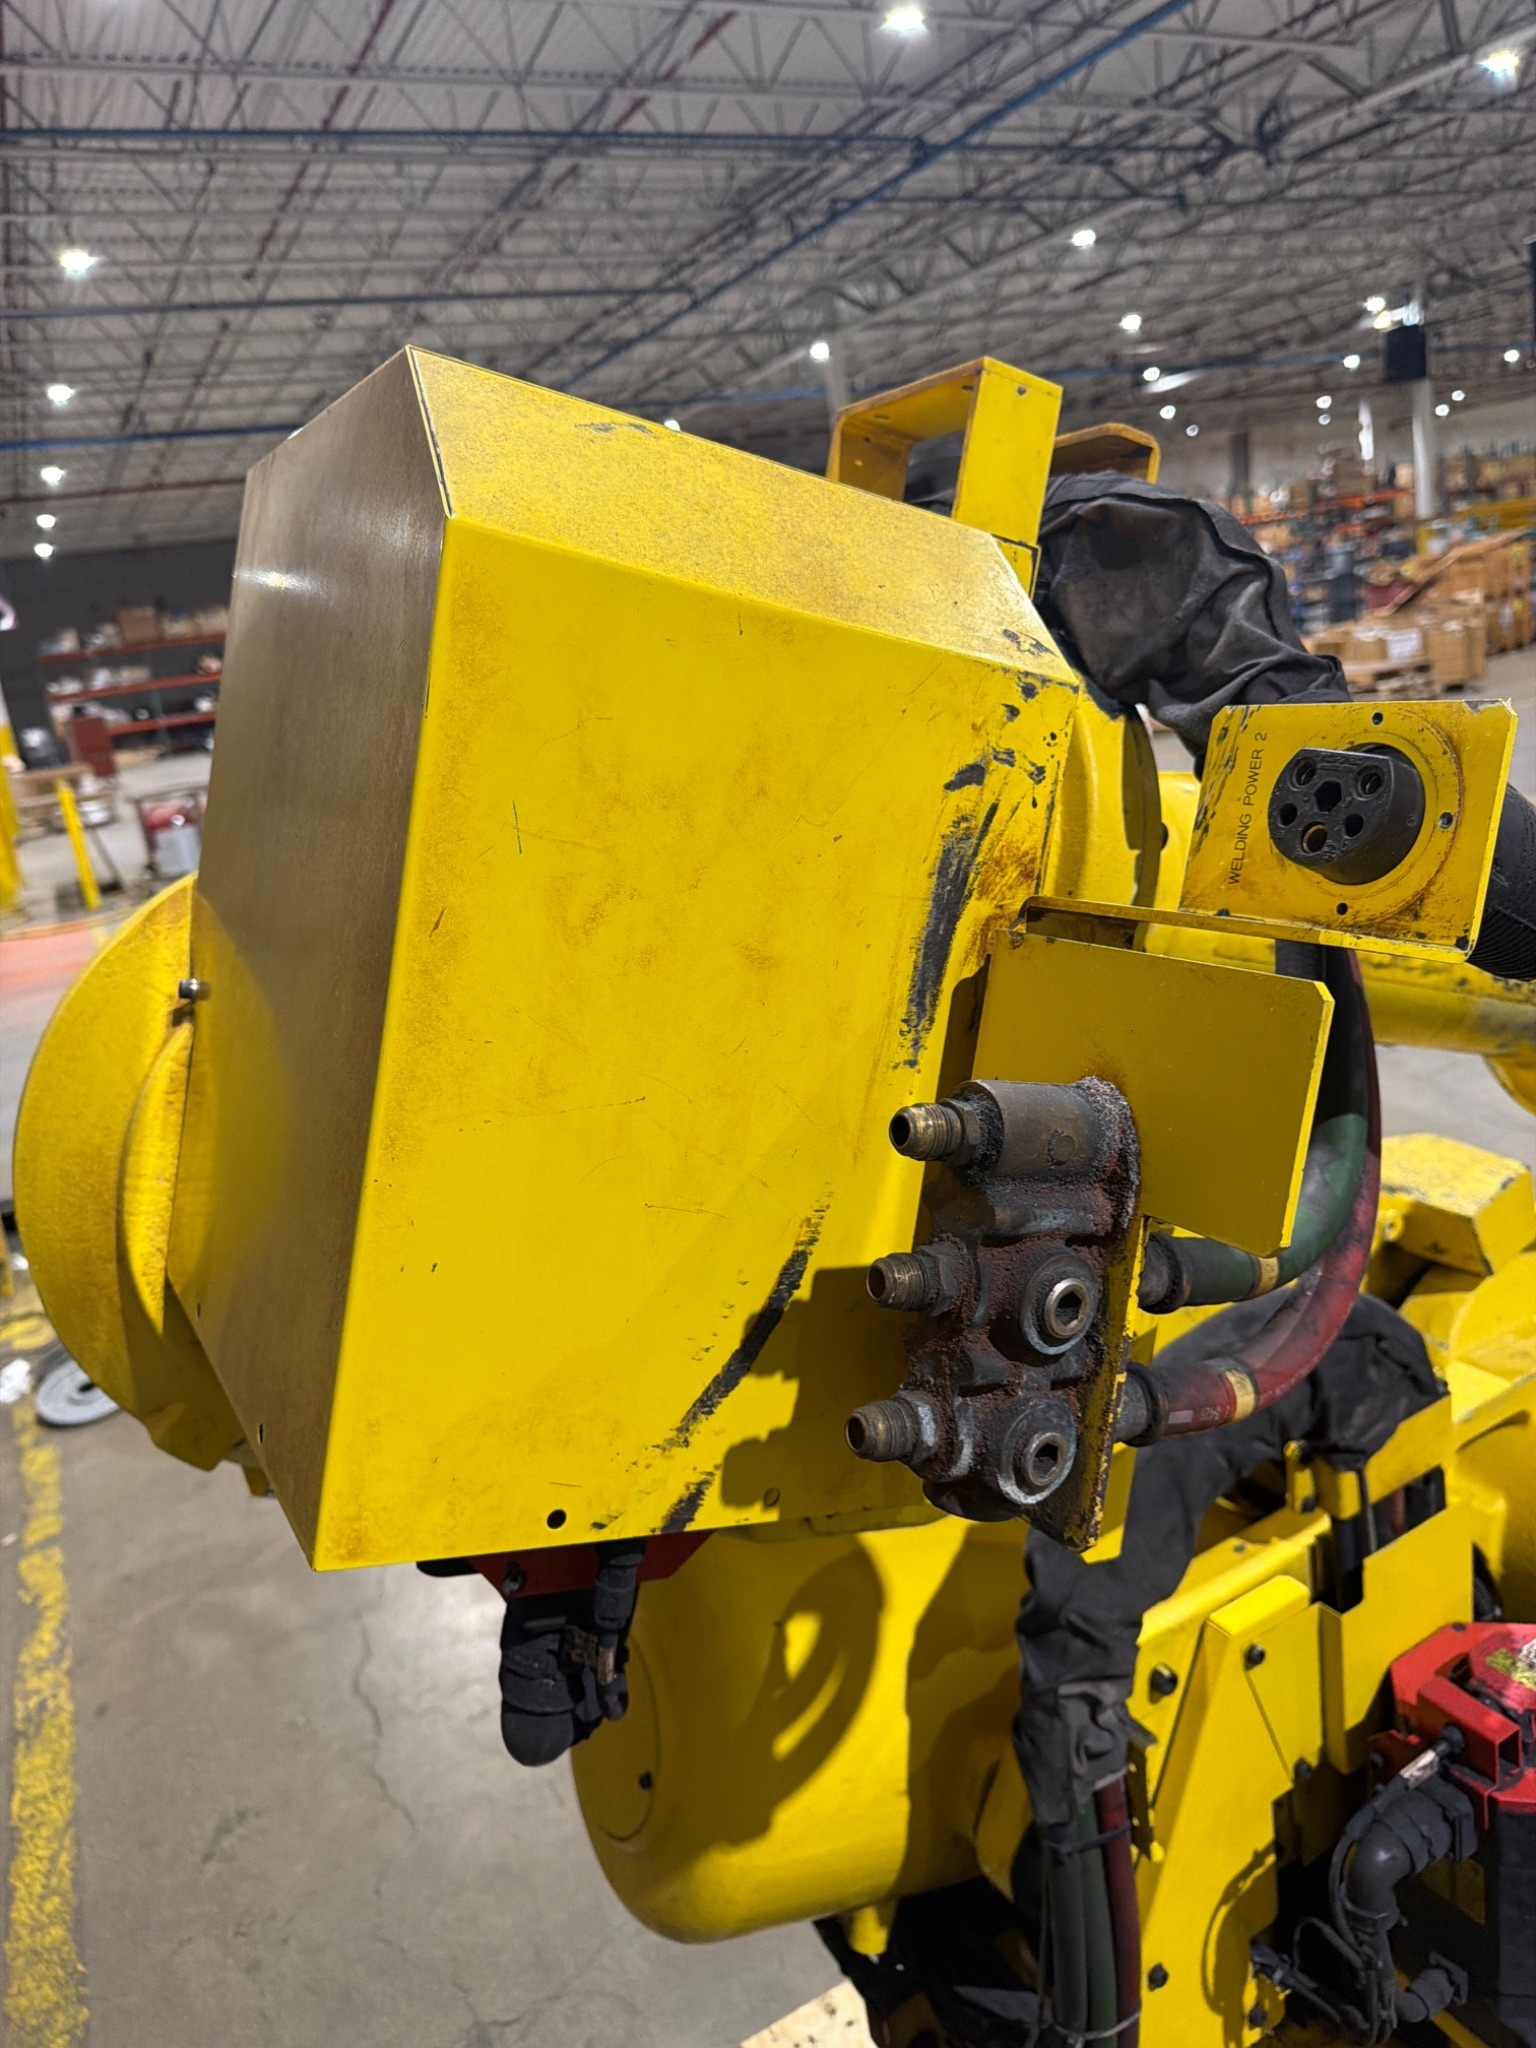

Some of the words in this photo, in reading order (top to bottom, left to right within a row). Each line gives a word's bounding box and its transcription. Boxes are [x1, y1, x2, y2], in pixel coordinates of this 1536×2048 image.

[1228, 813, 1252, 885] WELDING
[1243, 748, 1264, 806] POWER
[1254, 731, 1268, 742] 2
